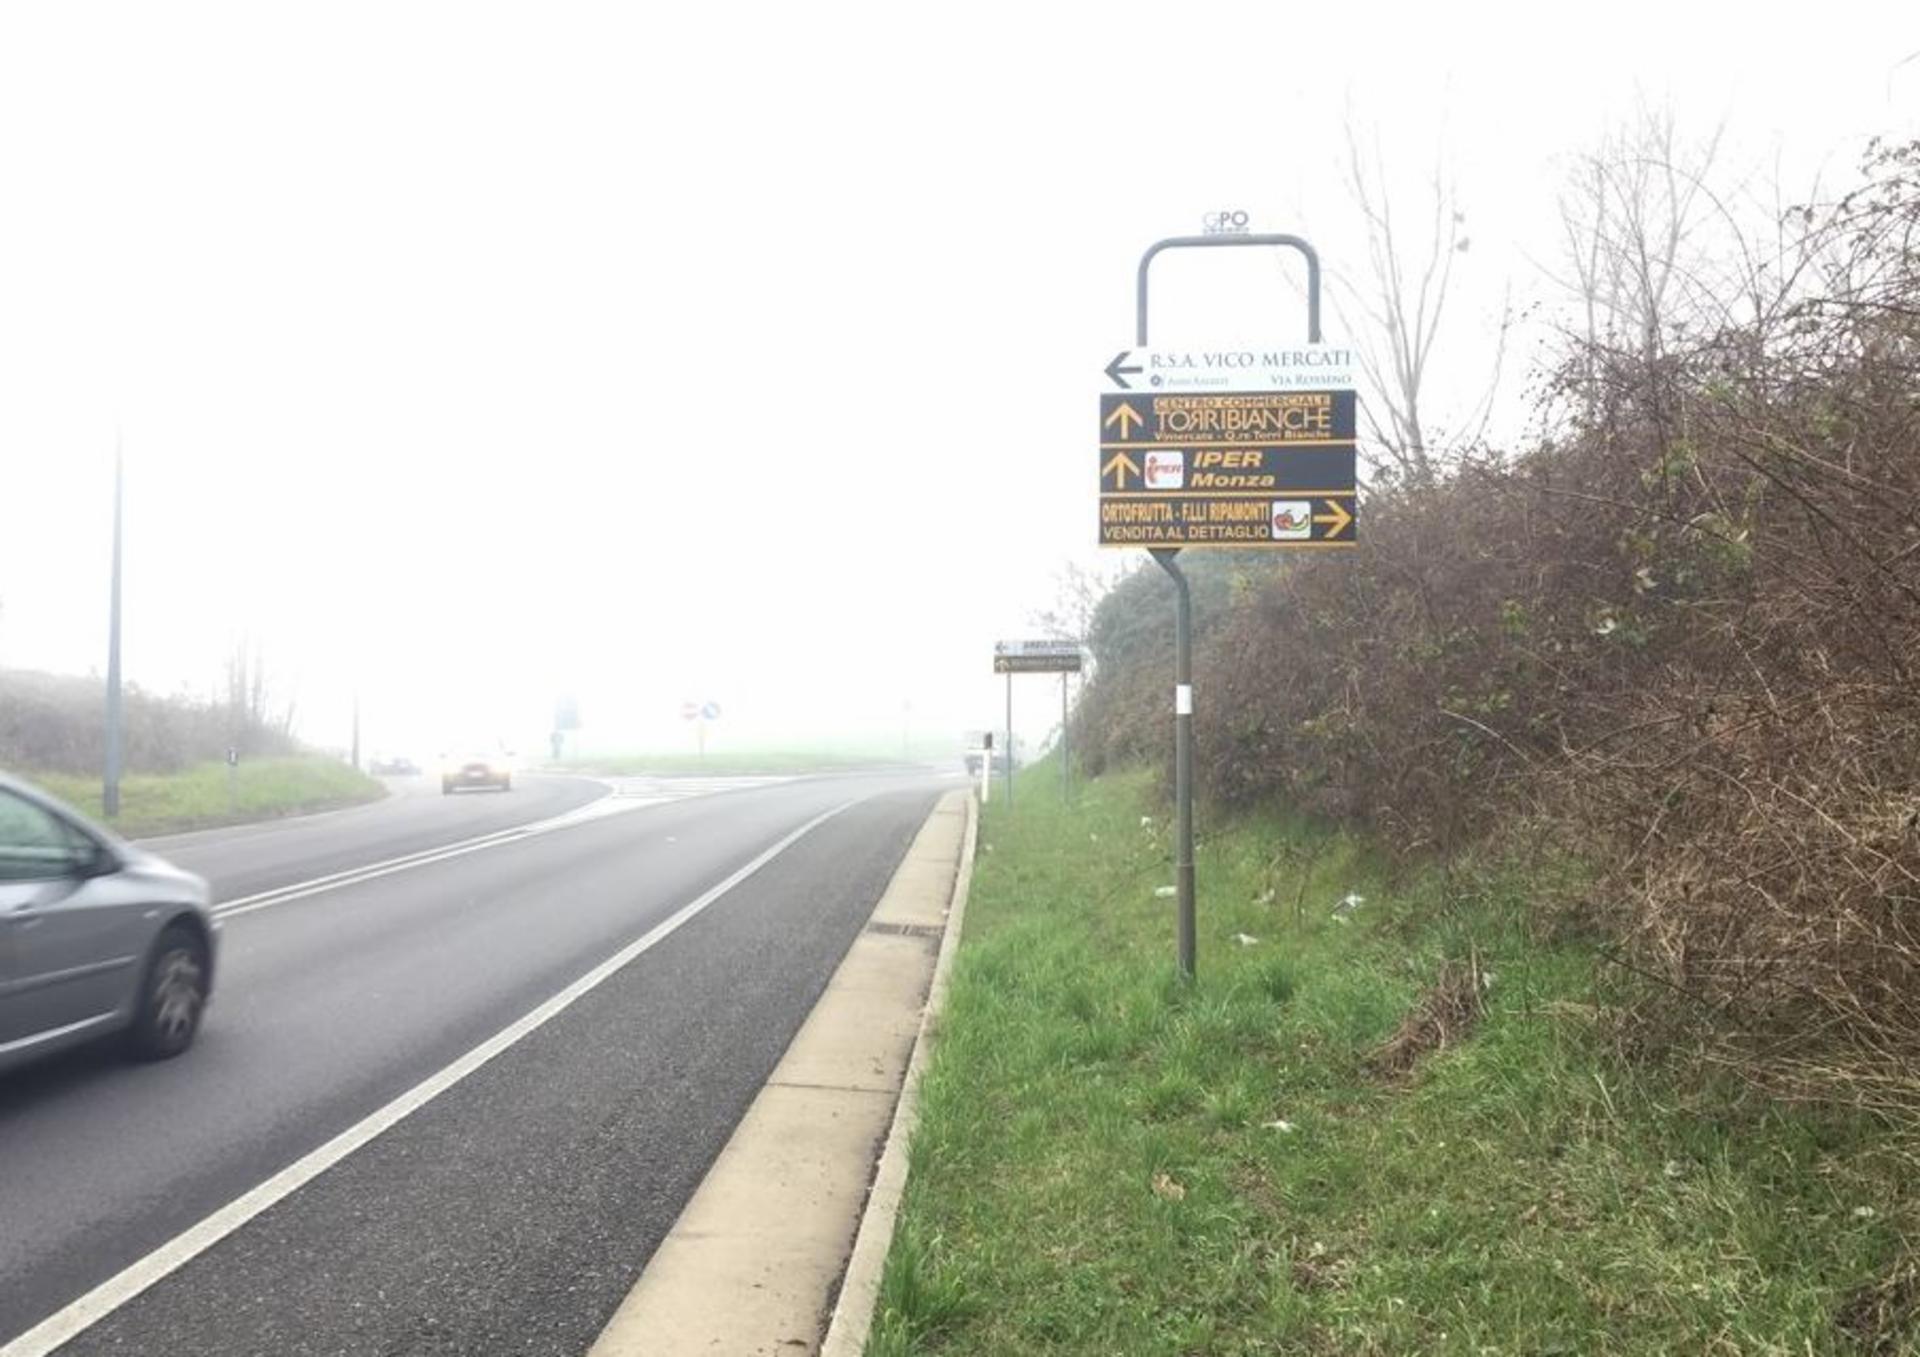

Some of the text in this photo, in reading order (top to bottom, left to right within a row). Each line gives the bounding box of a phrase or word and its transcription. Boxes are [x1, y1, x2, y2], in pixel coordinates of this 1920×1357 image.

[1151, 351, 1351, 369] R.S.A. VICO MERCATI
[1153, 396, 1216, 409] CENTRO
[1155, 431, 1213, 441] Vimercate
[1253, 430, 1282, 440] Torri
[1284, 430, 1331, 440] Bianche
[1193, 451, 1263, 468] IPER
[1190, 472, 1275, 488] Monza
[1102, 502, 1173, 522] ORTOFRUTTA
[1209, 501, 1270, 521] RIPAMONTI
[1104, 525, 1269, 540] VENDITA AL DETTAGLIO
